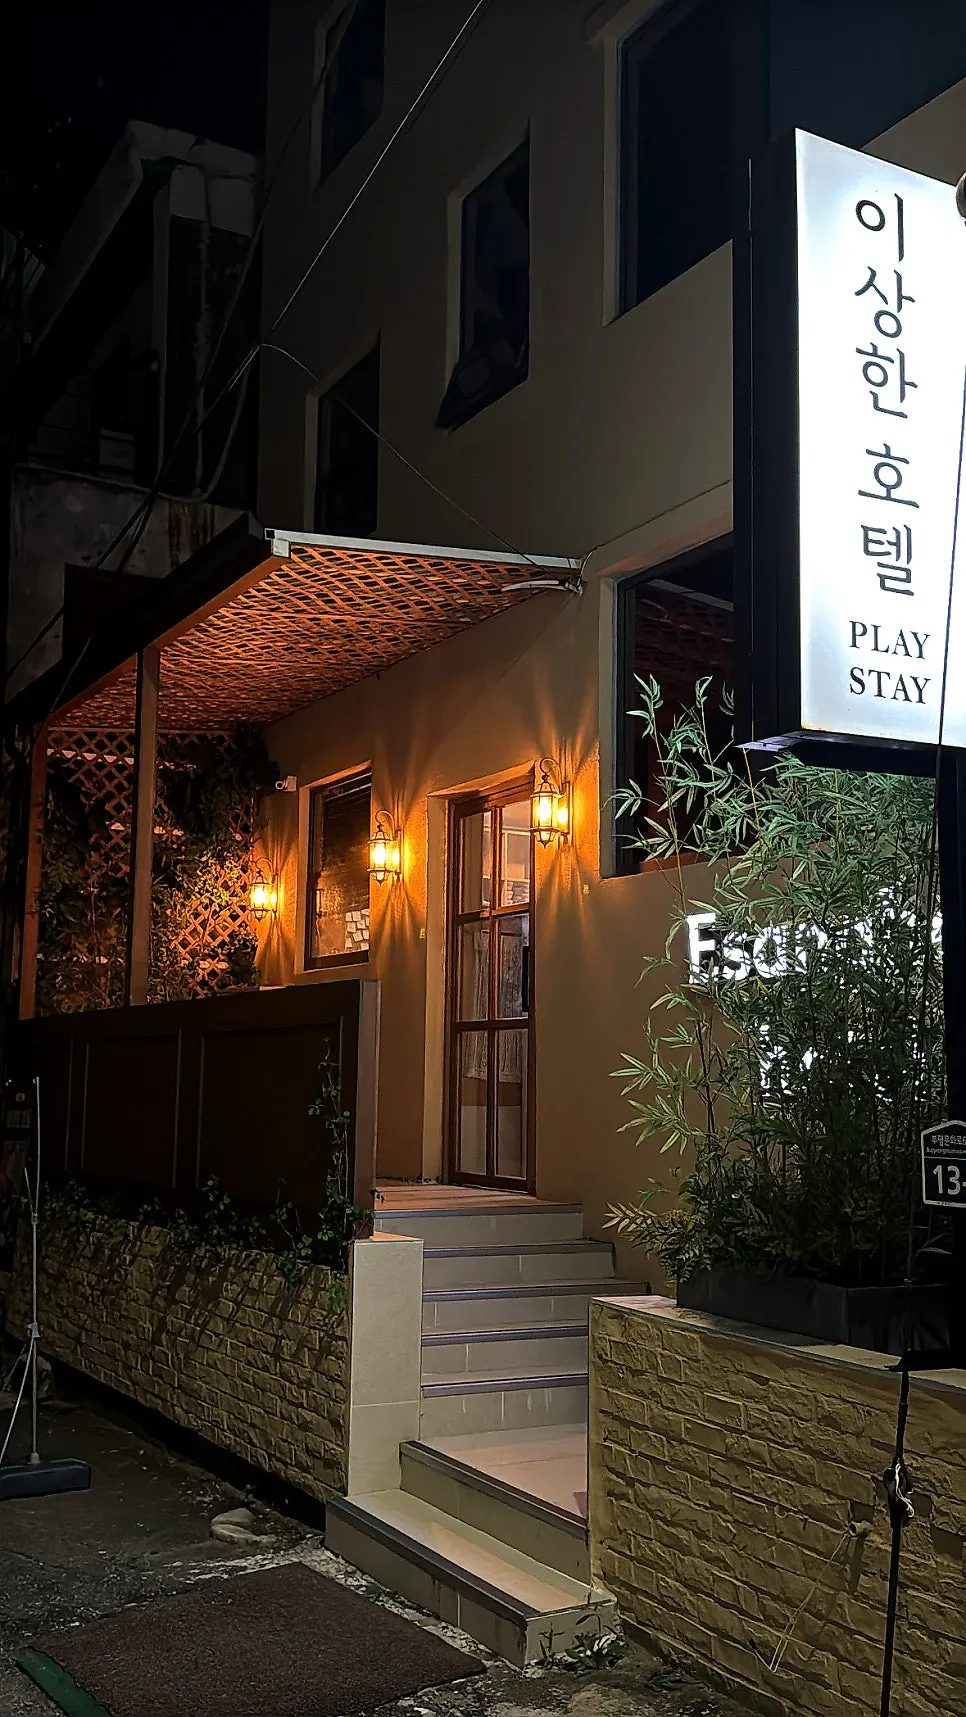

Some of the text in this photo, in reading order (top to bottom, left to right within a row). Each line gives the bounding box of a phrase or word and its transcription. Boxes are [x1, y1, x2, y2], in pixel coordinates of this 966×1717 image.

[854, 192, 920, 597] 이상한 호텔
[849, 620, 931, 660] PLAY
[849, 666, 931, 705] STAY
